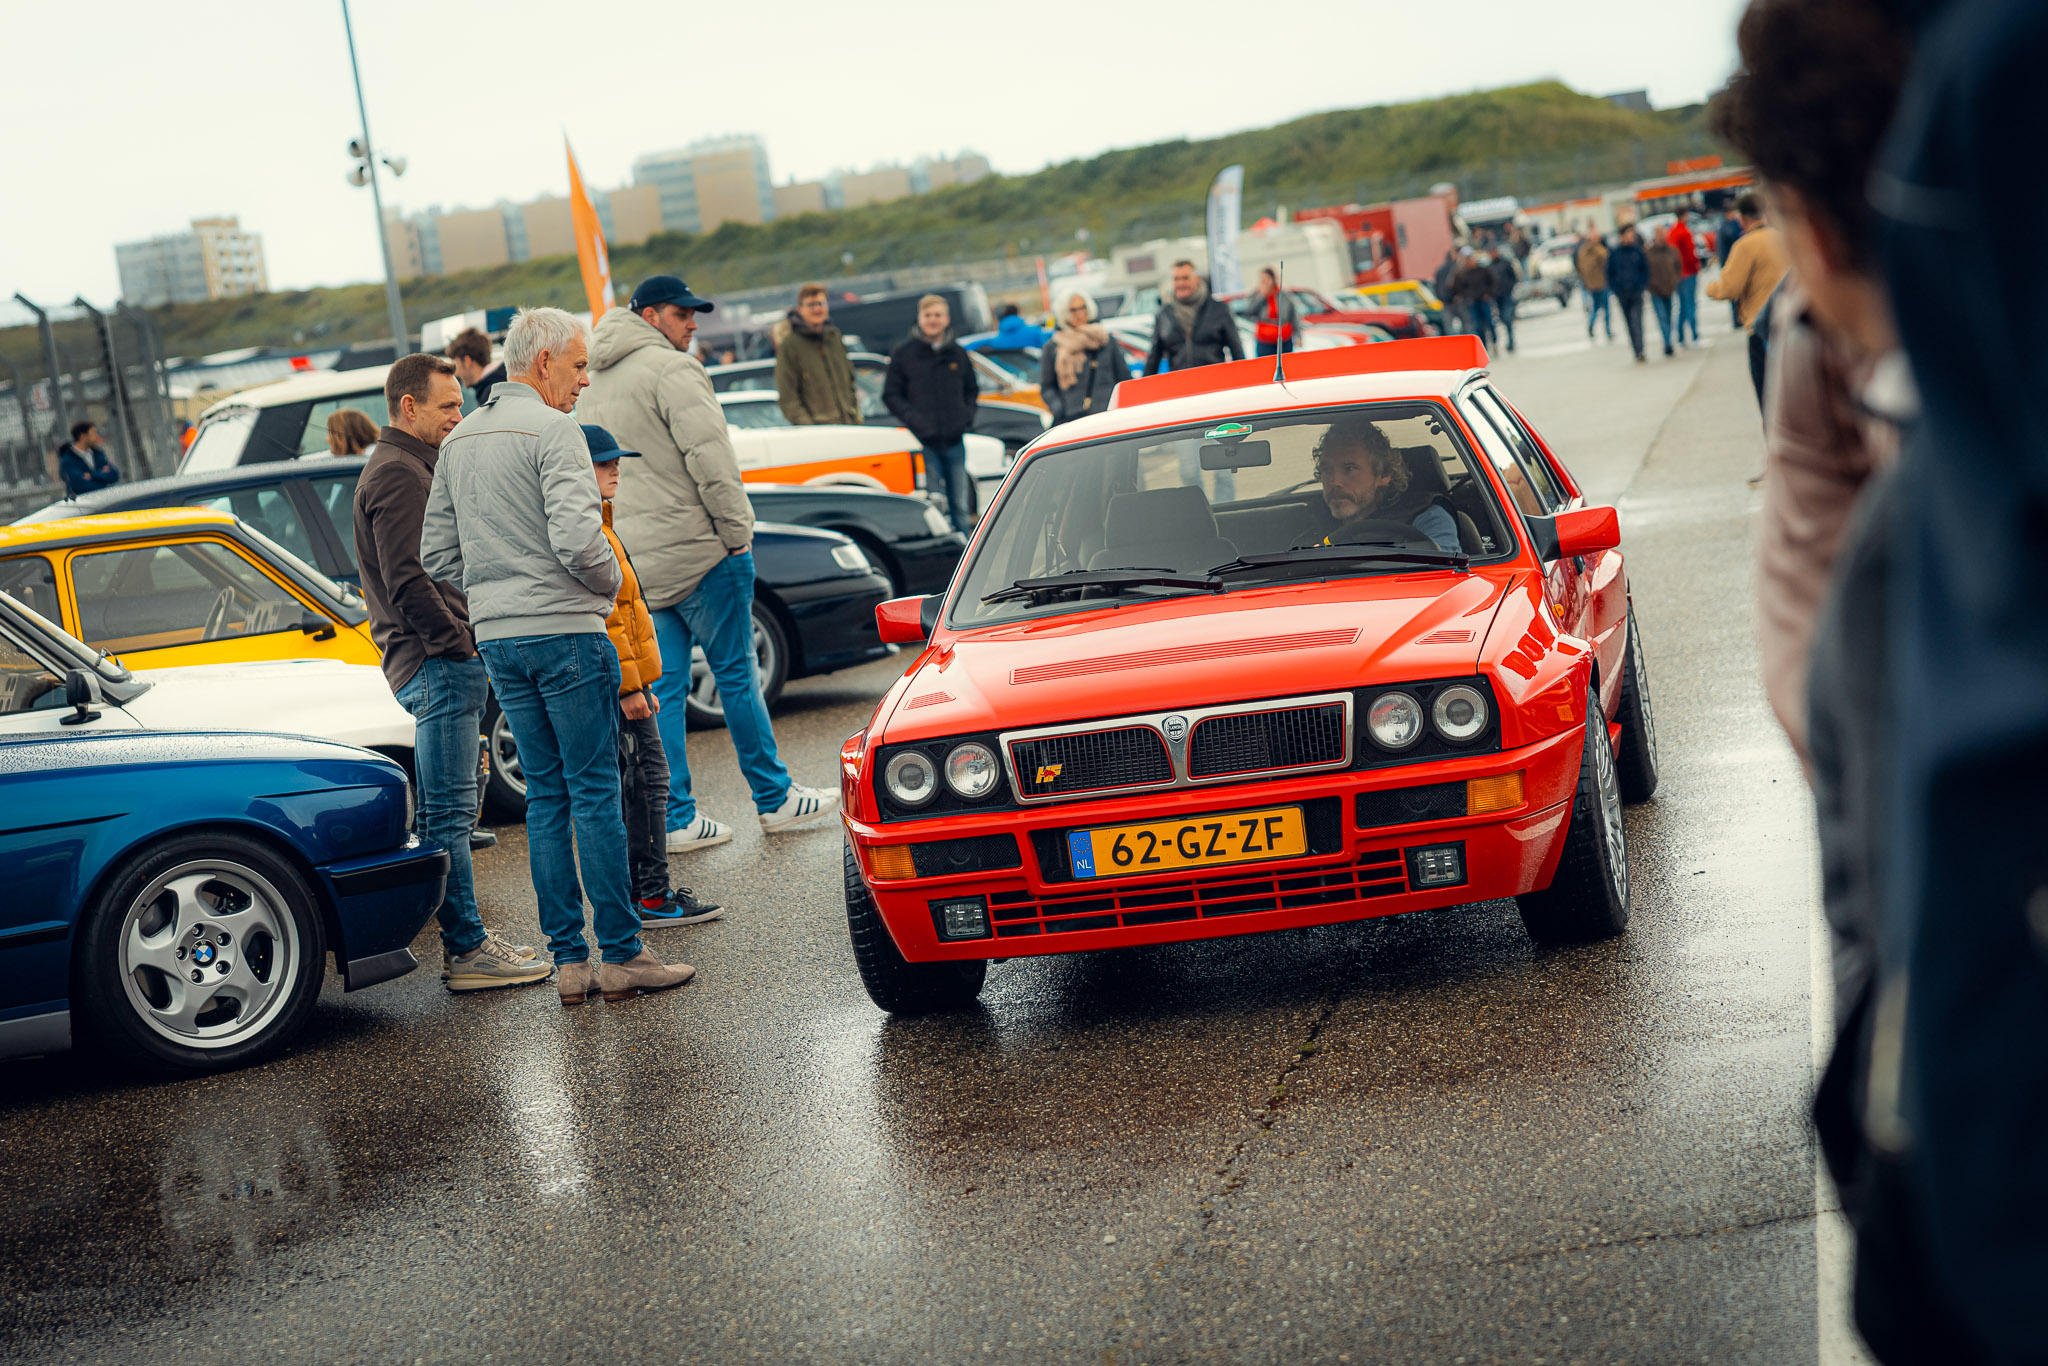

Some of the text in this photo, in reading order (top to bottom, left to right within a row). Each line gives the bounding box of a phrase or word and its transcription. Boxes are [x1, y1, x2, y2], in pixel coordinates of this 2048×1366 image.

[1035, 764, 1062, 783] HF
[1111, 816, 1283, 866] 62-GZ-ZF
[1076, 859, 1092, 870] NL
